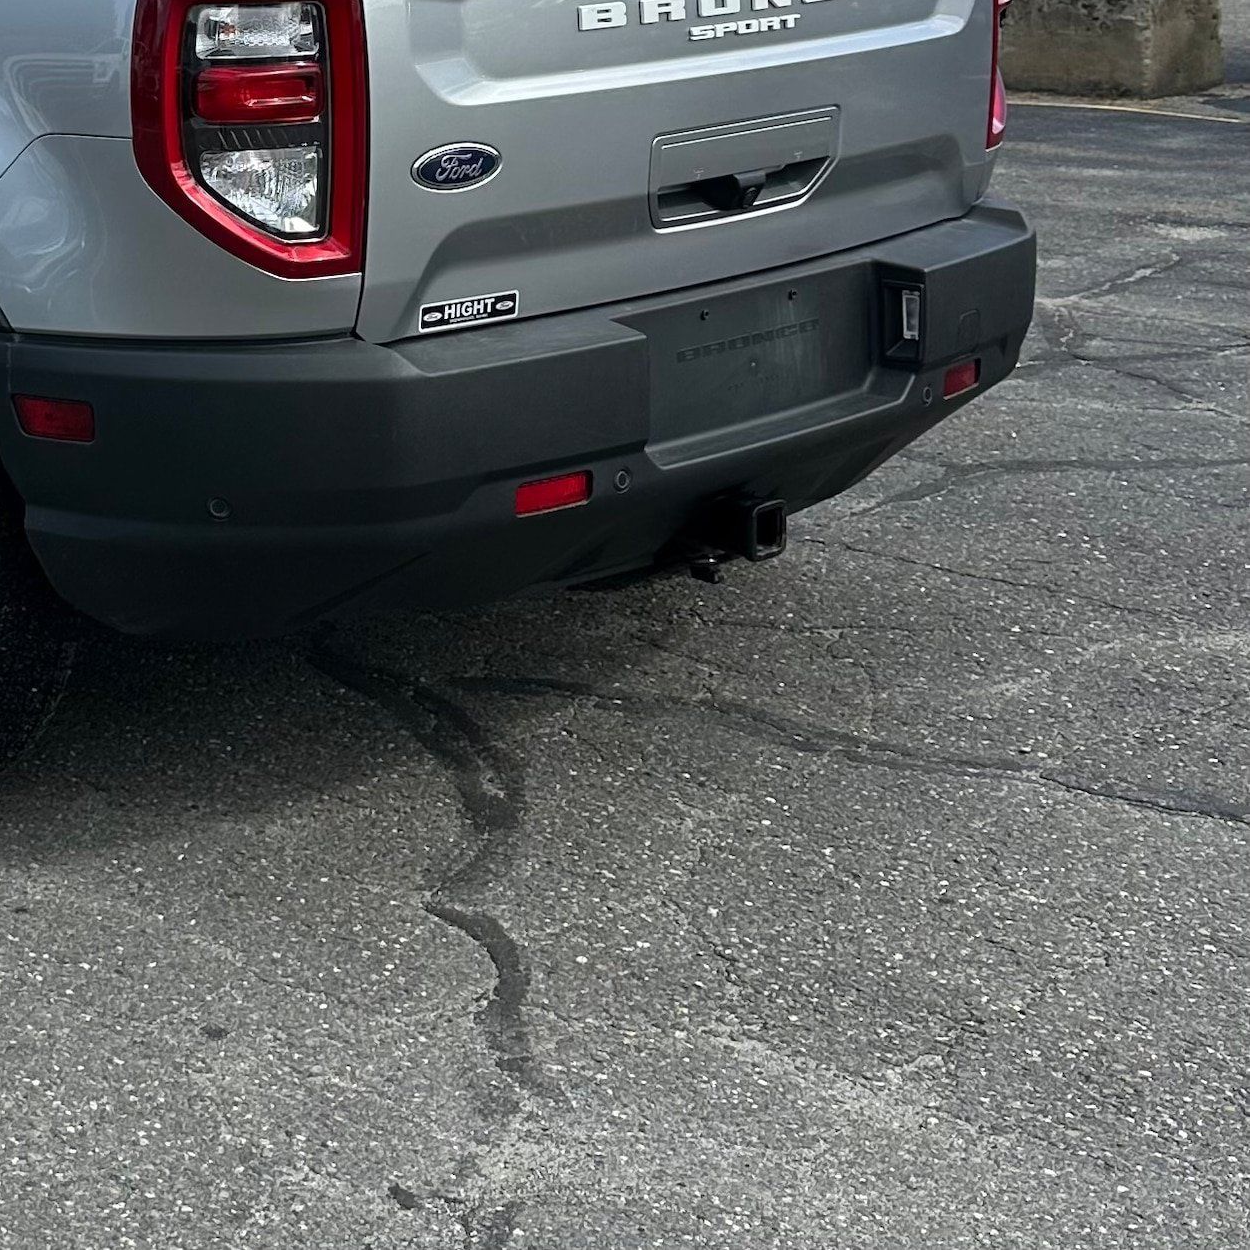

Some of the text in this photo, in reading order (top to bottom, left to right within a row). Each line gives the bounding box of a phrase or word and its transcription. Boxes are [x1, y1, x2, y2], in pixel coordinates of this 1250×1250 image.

[689, 14, 801, 41] SPORT
[435, 153, 484, 182] Ford
[444, 297, 495, 320] HIGHT
[676, 318, 820, 363] BRONCO
